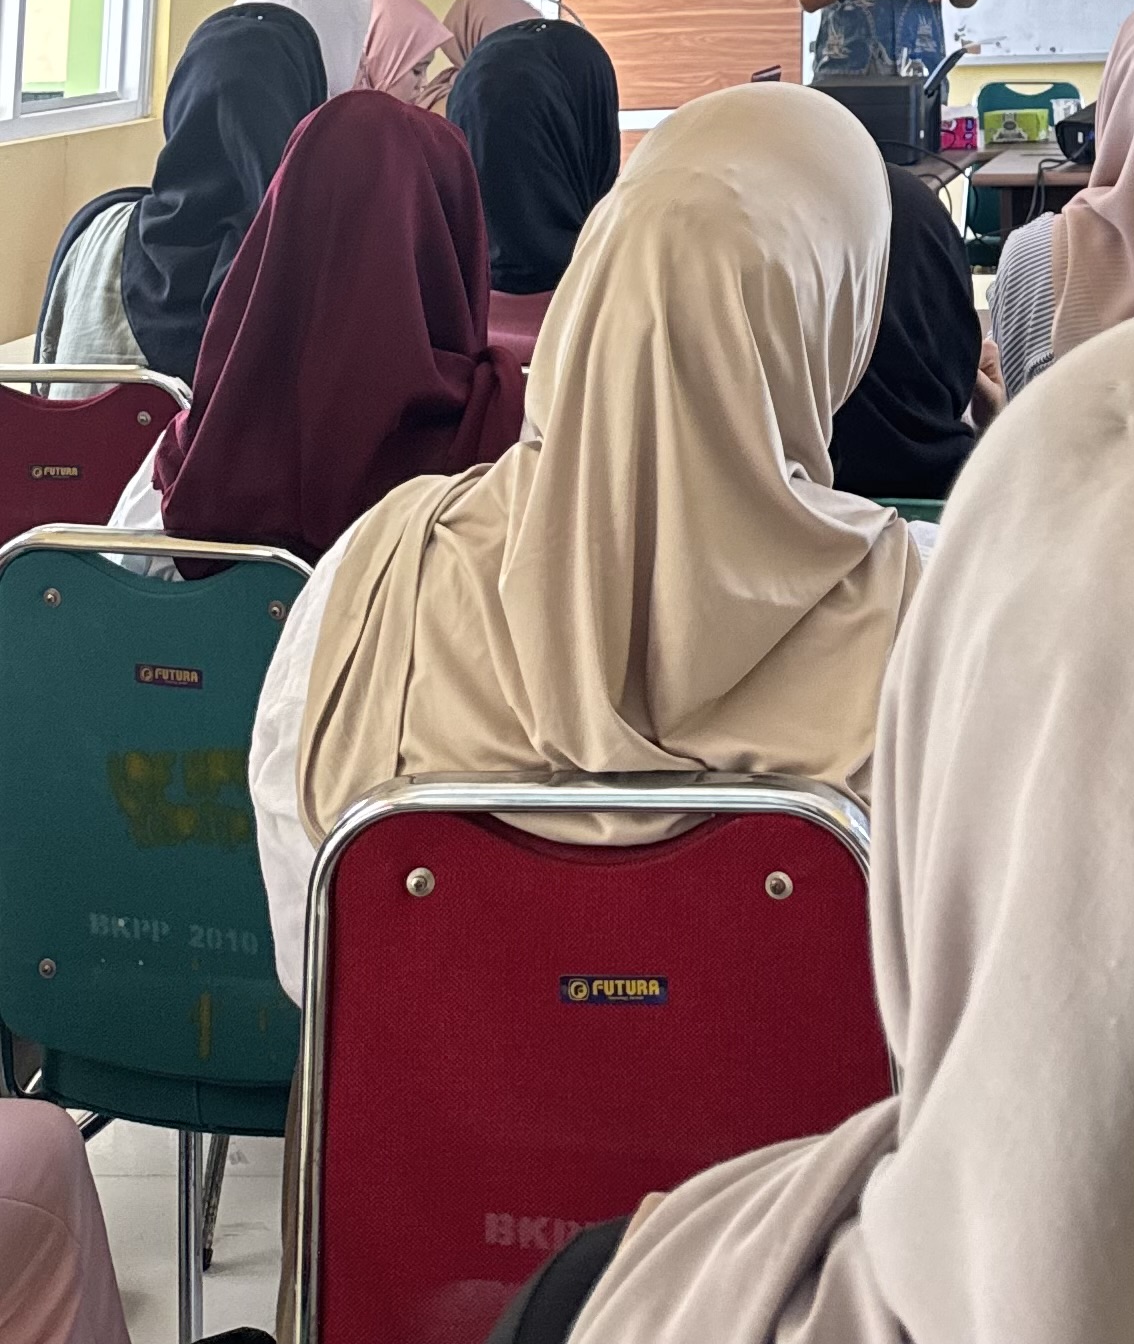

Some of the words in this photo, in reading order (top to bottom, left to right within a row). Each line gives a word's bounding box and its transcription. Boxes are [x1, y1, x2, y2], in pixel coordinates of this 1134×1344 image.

[154, 666, 199, 684] FUTURA
[188, 923, 259, 956] 2010
[592, 979, 660, 996] FUTURA
